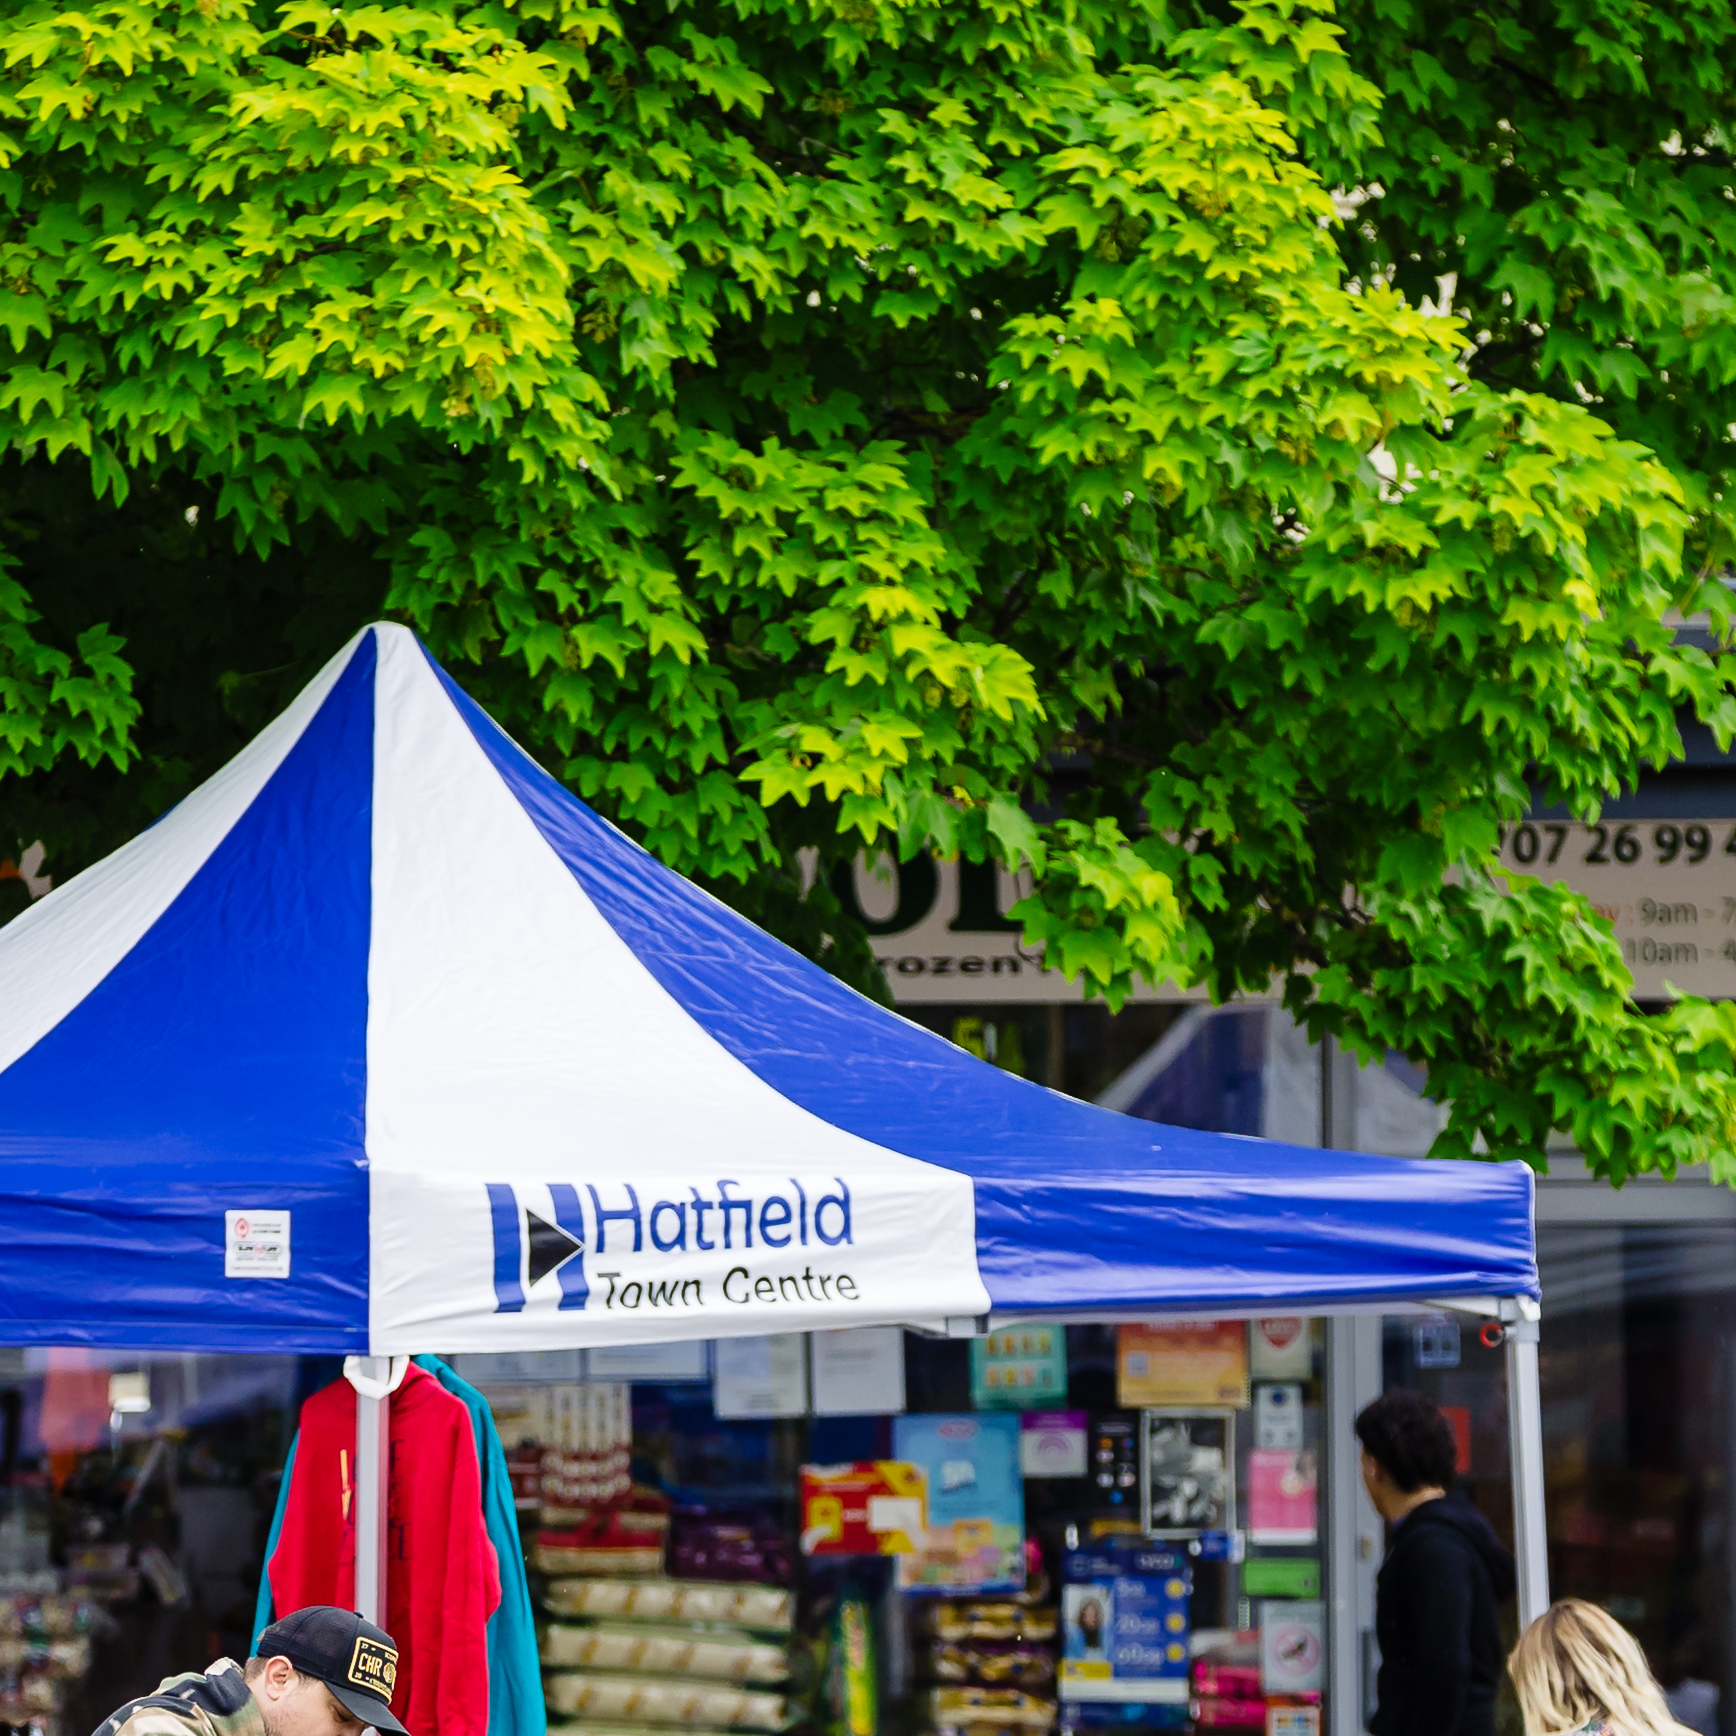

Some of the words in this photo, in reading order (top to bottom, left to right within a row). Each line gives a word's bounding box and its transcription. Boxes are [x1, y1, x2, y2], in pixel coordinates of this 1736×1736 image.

[1499, 824, 1569, 866] 07
[1584, 824, 1642, 866] 26
[1653, 824, 1713, 866] 99
[1638, 896, 1699, 926] 9am
[875, 953, 1024, 977] rozen
[585, 1177, 854, 1254] Hatfield
[597, 1272, 706, 1309] Town
[722, 1265, 860, 1304] Centre
[357, 1651, 383, 1678] CHR
